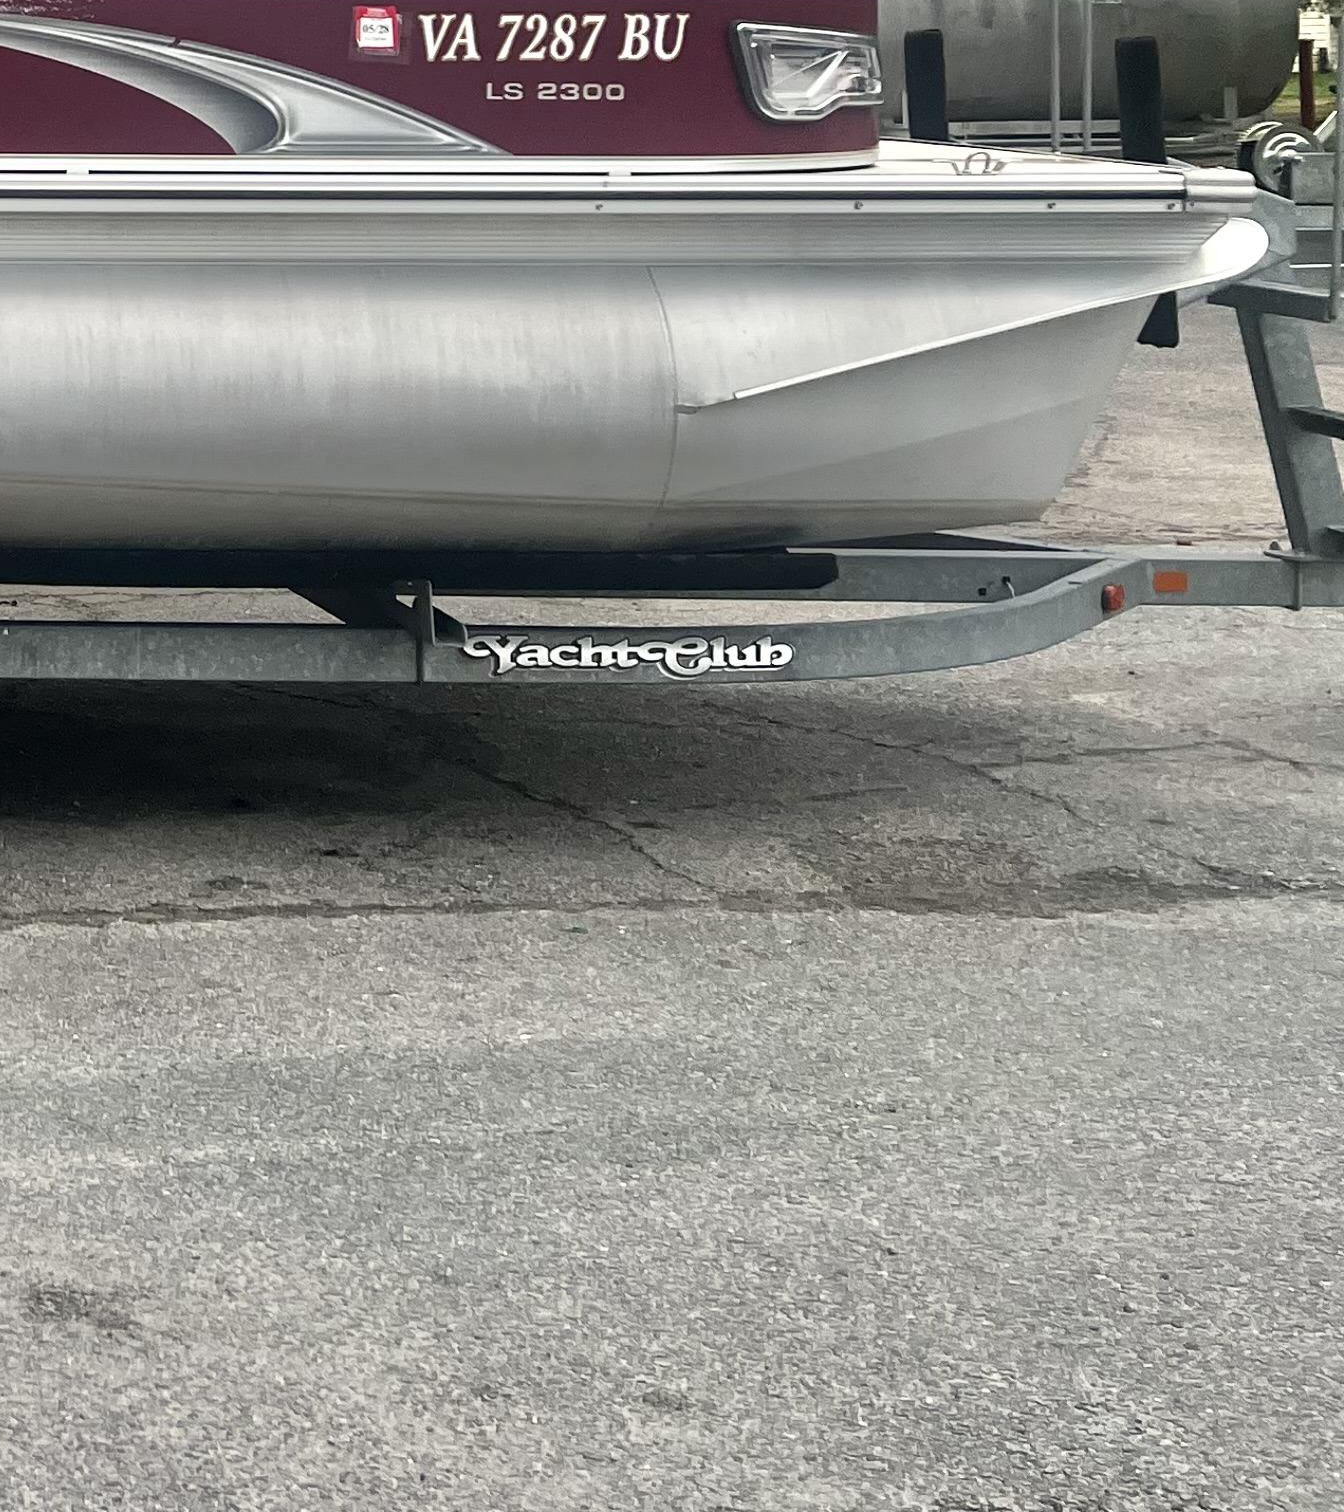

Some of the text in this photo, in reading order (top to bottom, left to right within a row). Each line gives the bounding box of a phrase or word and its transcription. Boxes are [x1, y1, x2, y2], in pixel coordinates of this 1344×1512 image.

[418, 12, 690, 63] VA 7287 BU
[485, 82, 626, 101] LS 2300
